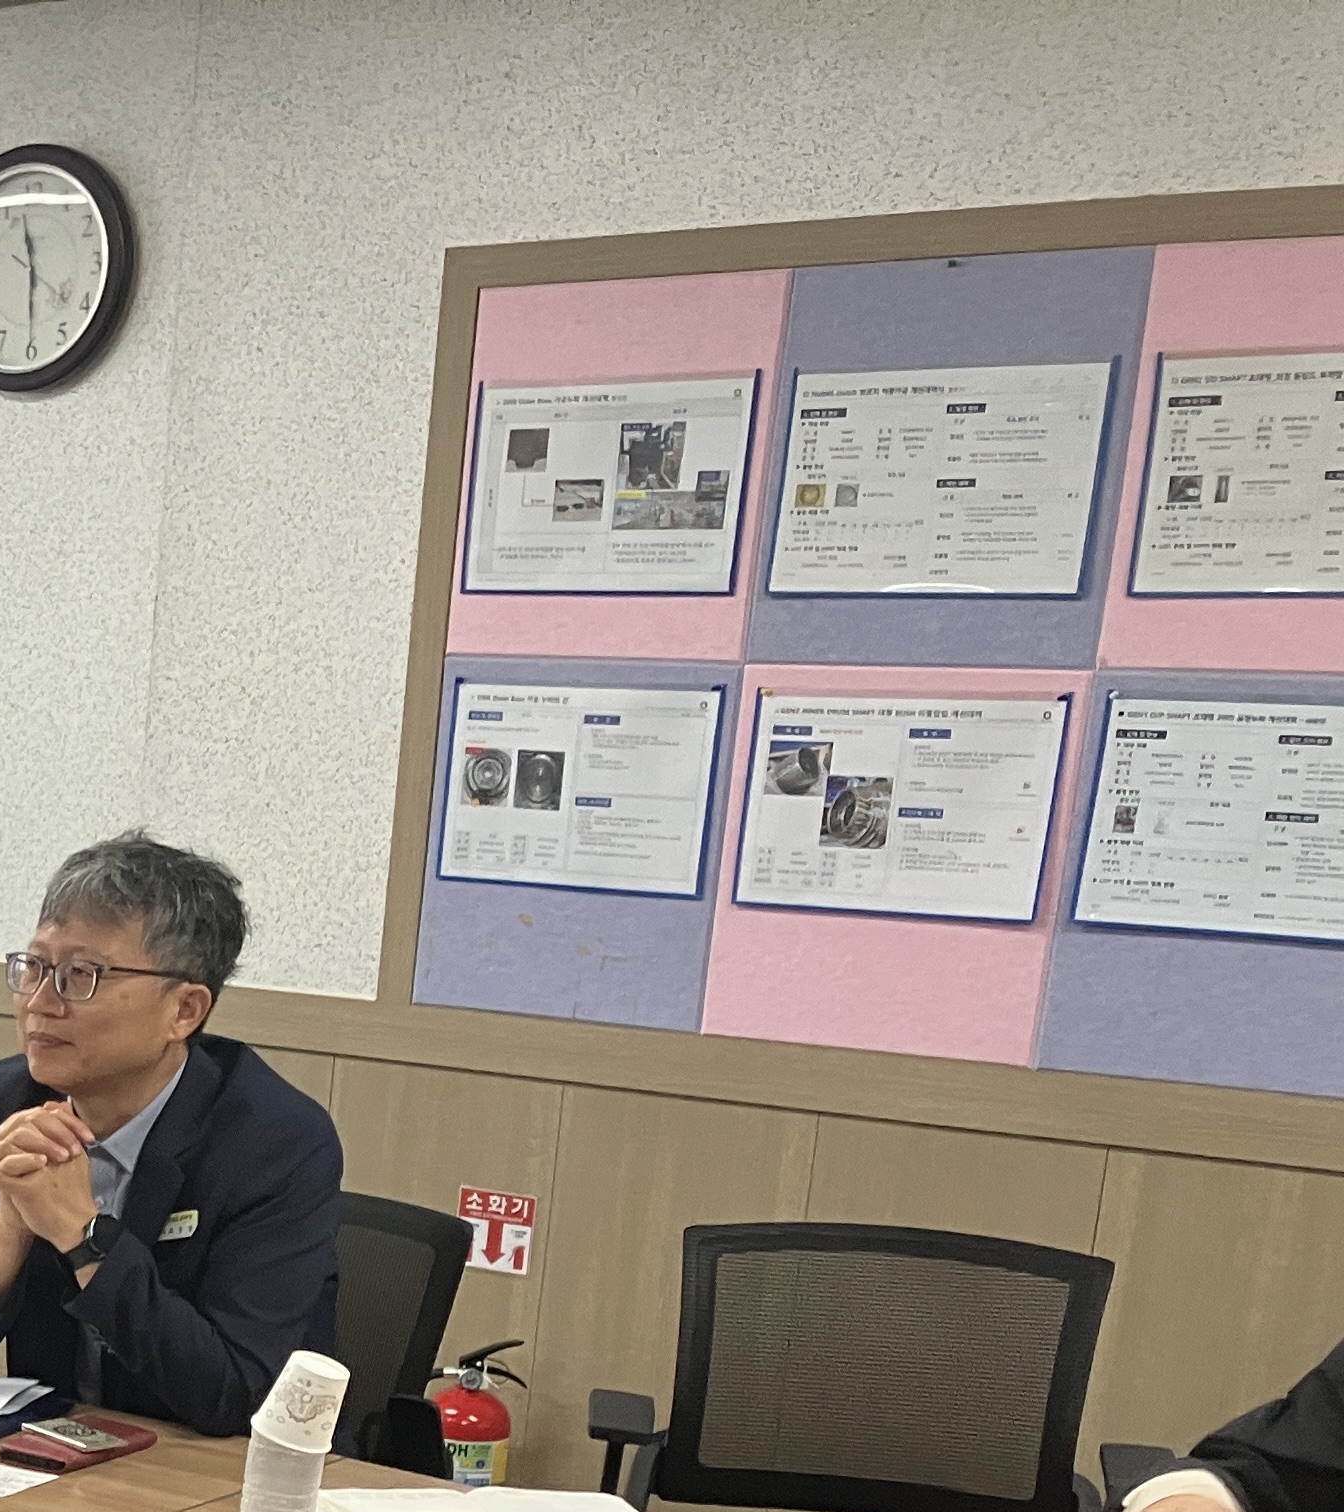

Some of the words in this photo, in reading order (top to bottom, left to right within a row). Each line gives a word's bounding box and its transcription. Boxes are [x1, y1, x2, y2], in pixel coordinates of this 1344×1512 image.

[80, 213, 93, 238] 2
[90, 250, 102, 275] 3
[78, 291, 90, 315] 4
[55, 321, 68, 347] 5
[25, 340, 38, 361] 6
[465, 1191, 530, 1219] 소화기
